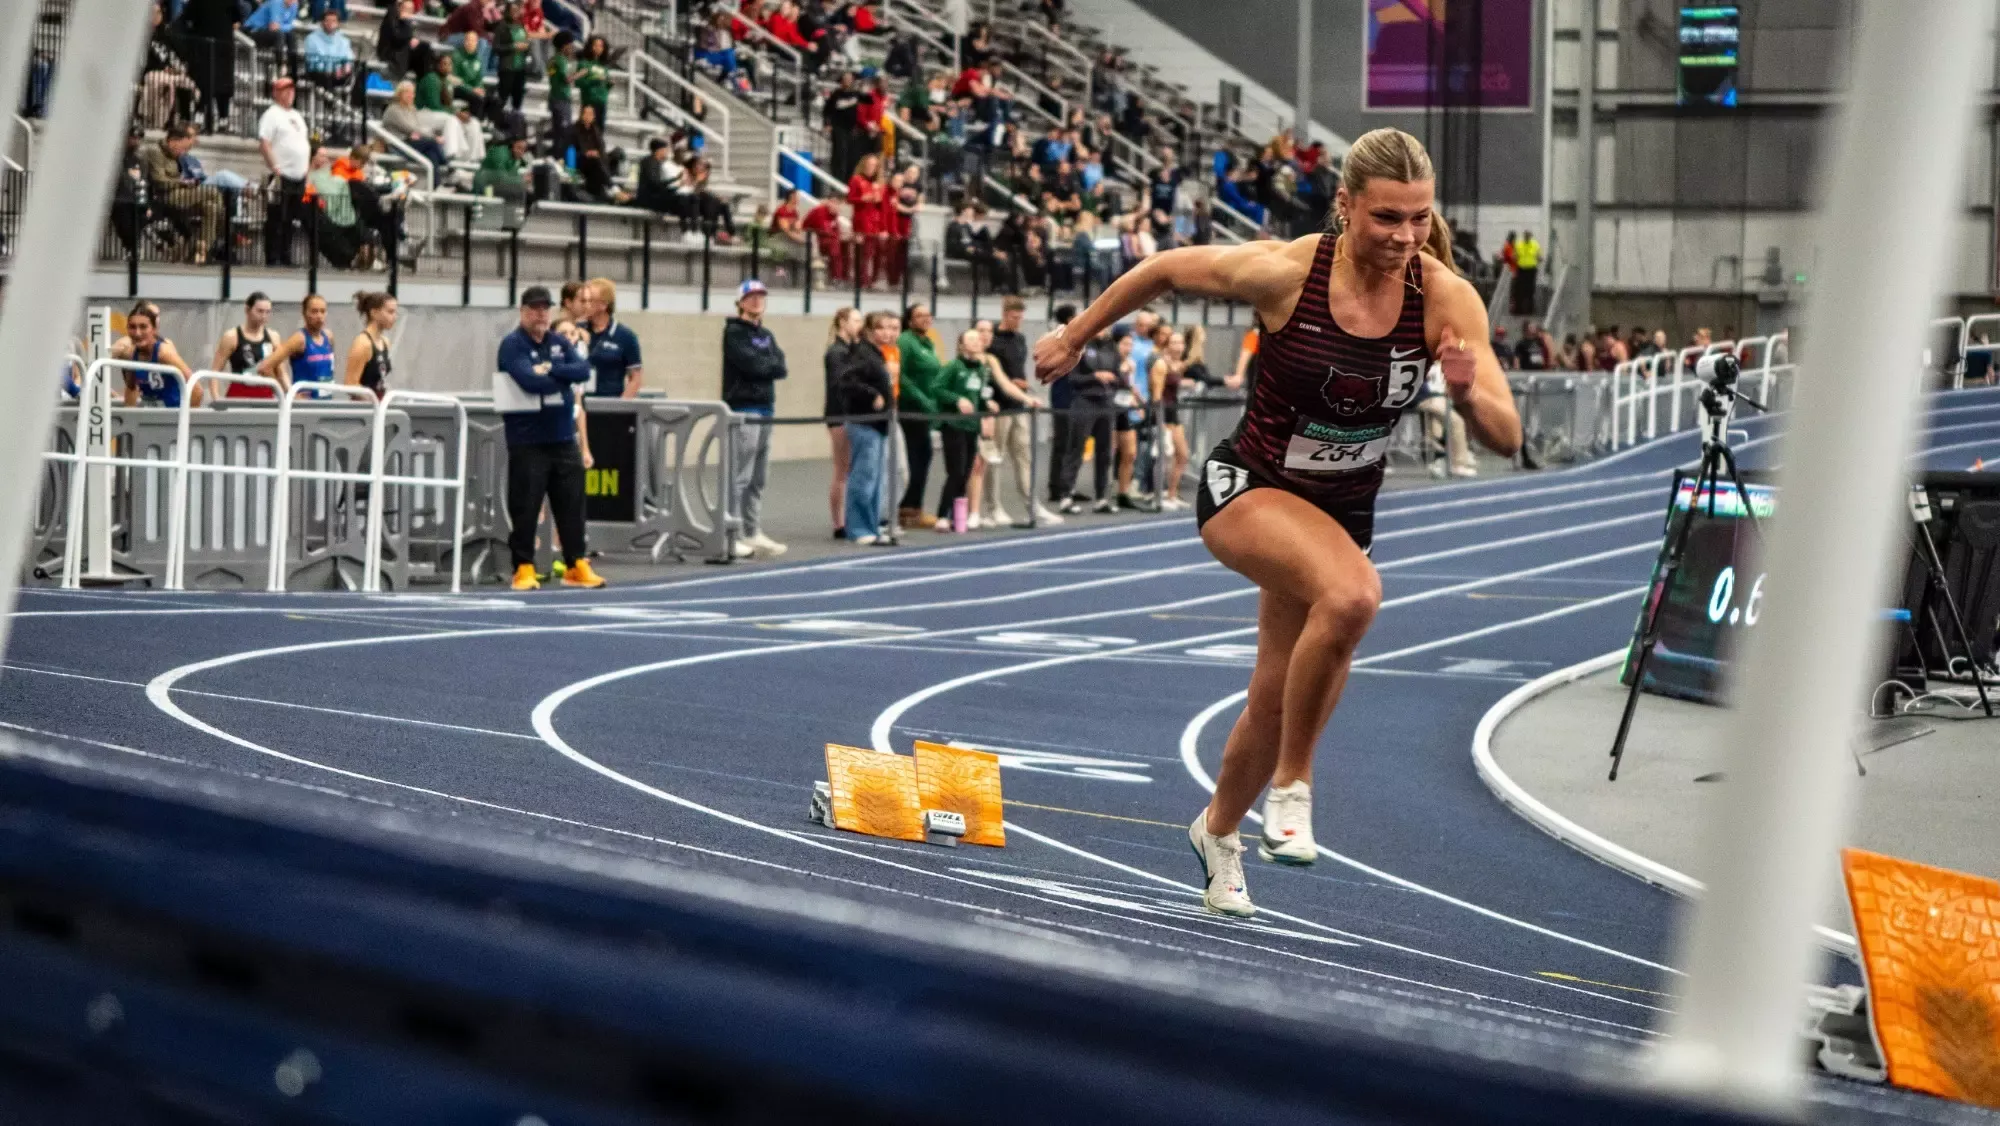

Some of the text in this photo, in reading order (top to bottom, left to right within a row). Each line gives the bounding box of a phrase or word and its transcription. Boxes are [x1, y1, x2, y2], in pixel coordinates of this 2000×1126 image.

[1391, 364, 1419, 406] 3
[1307, 421, 1386, 438] RIVERFRONT
[1309, 442, 1367, 462] 254
[1216, 464, 1237, 500] 3
